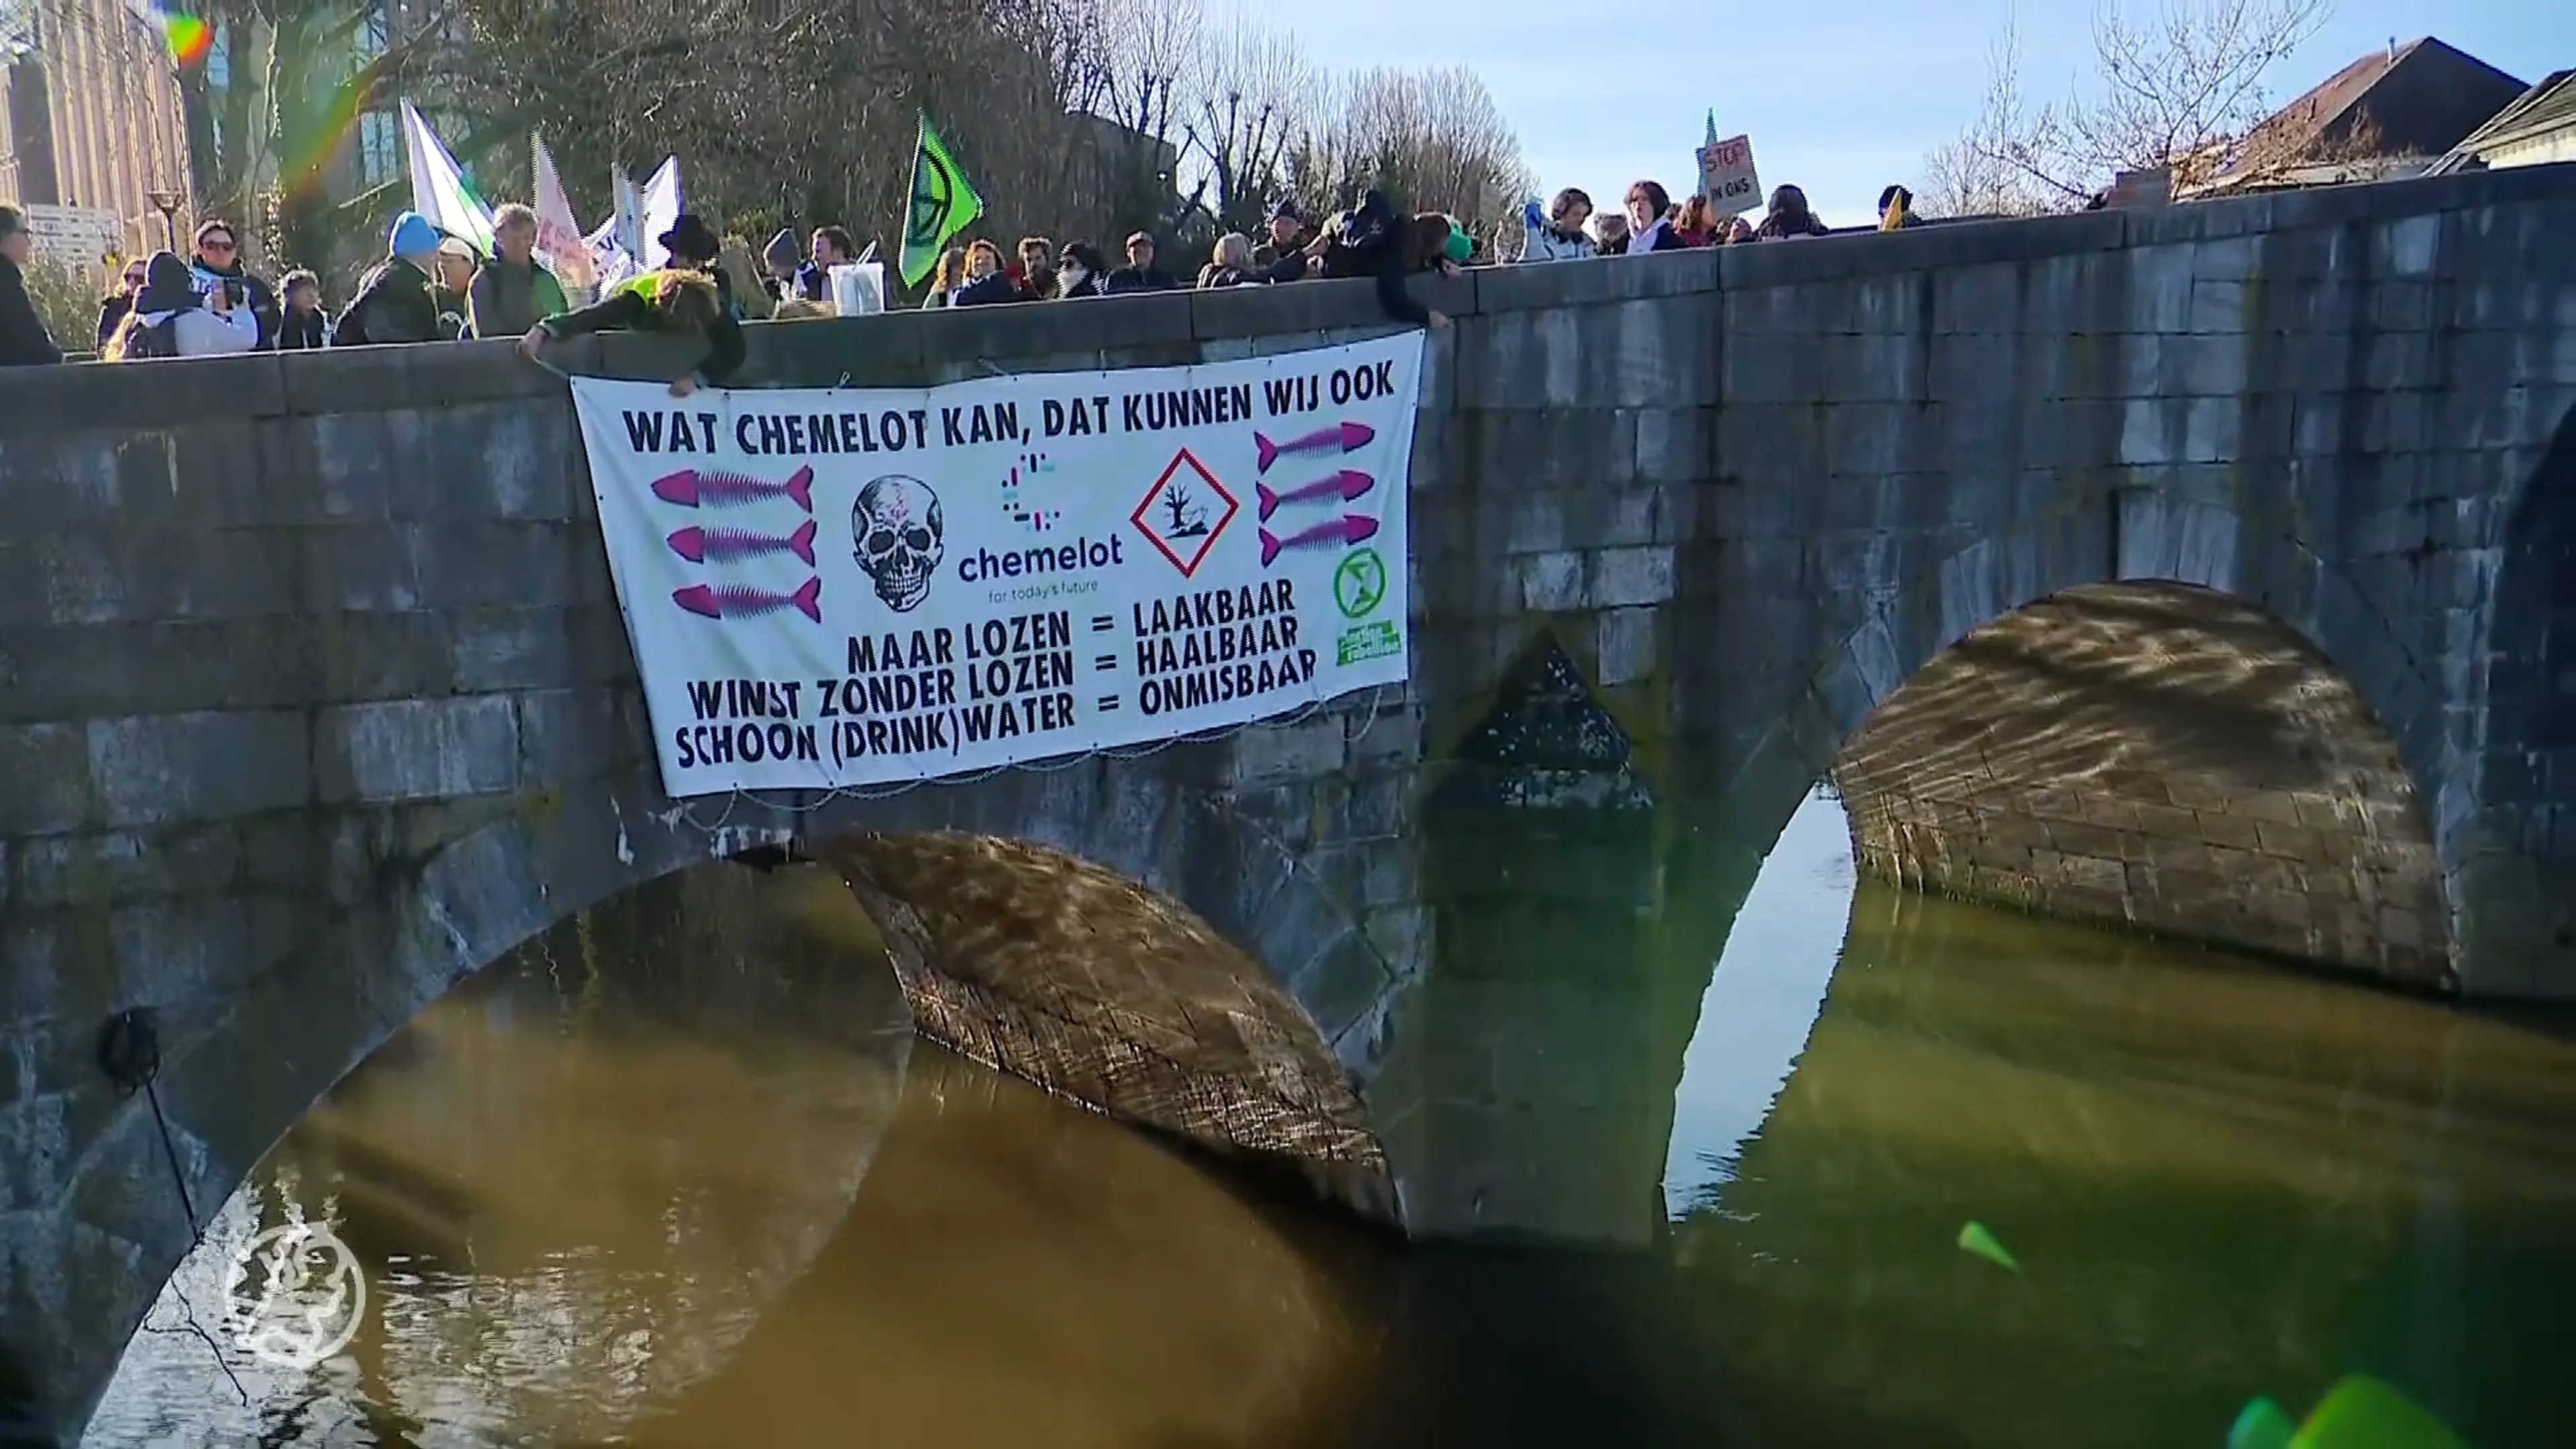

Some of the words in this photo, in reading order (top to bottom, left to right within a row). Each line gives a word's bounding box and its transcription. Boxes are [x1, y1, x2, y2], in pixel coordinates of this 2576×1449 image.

[623, 411, 718, 452] WAT
[737, 409, 927, 454] CHEMELOT
[941, 402, 1030, 447] KAN,
[1044, 396, 1109, 436] DAT
[1123, 383, 1252, 432] KUNNEN
[1263, 375, 1319, 416] WIJ
[1330, 360, 1394, 405] OOK
[959, 533, 1123, 582] chemelot
[989, 592, 1007, 603] for
[1012, 584, 1059, 600] today's
[1061, 579, 1097, 594] future
[687, 679, 801, 720] WINST
[816, 669, 956, 717] ZONDER
[969, 651, 1073, 700] LOZEN
[1136, 615, 1299, 677] HAALBAAR
[847, 627, 955, 674] MAAR
[965, 610, 1071, 658] LOZEN
[1133, 578, 1295, 637] LAAKBAAR
[676, 723, 820, 769] SCHOON
[830, 692, 1075, 771] (DRINK)WATER
[1139, 649, 1318, 716] ONMISBAAR
